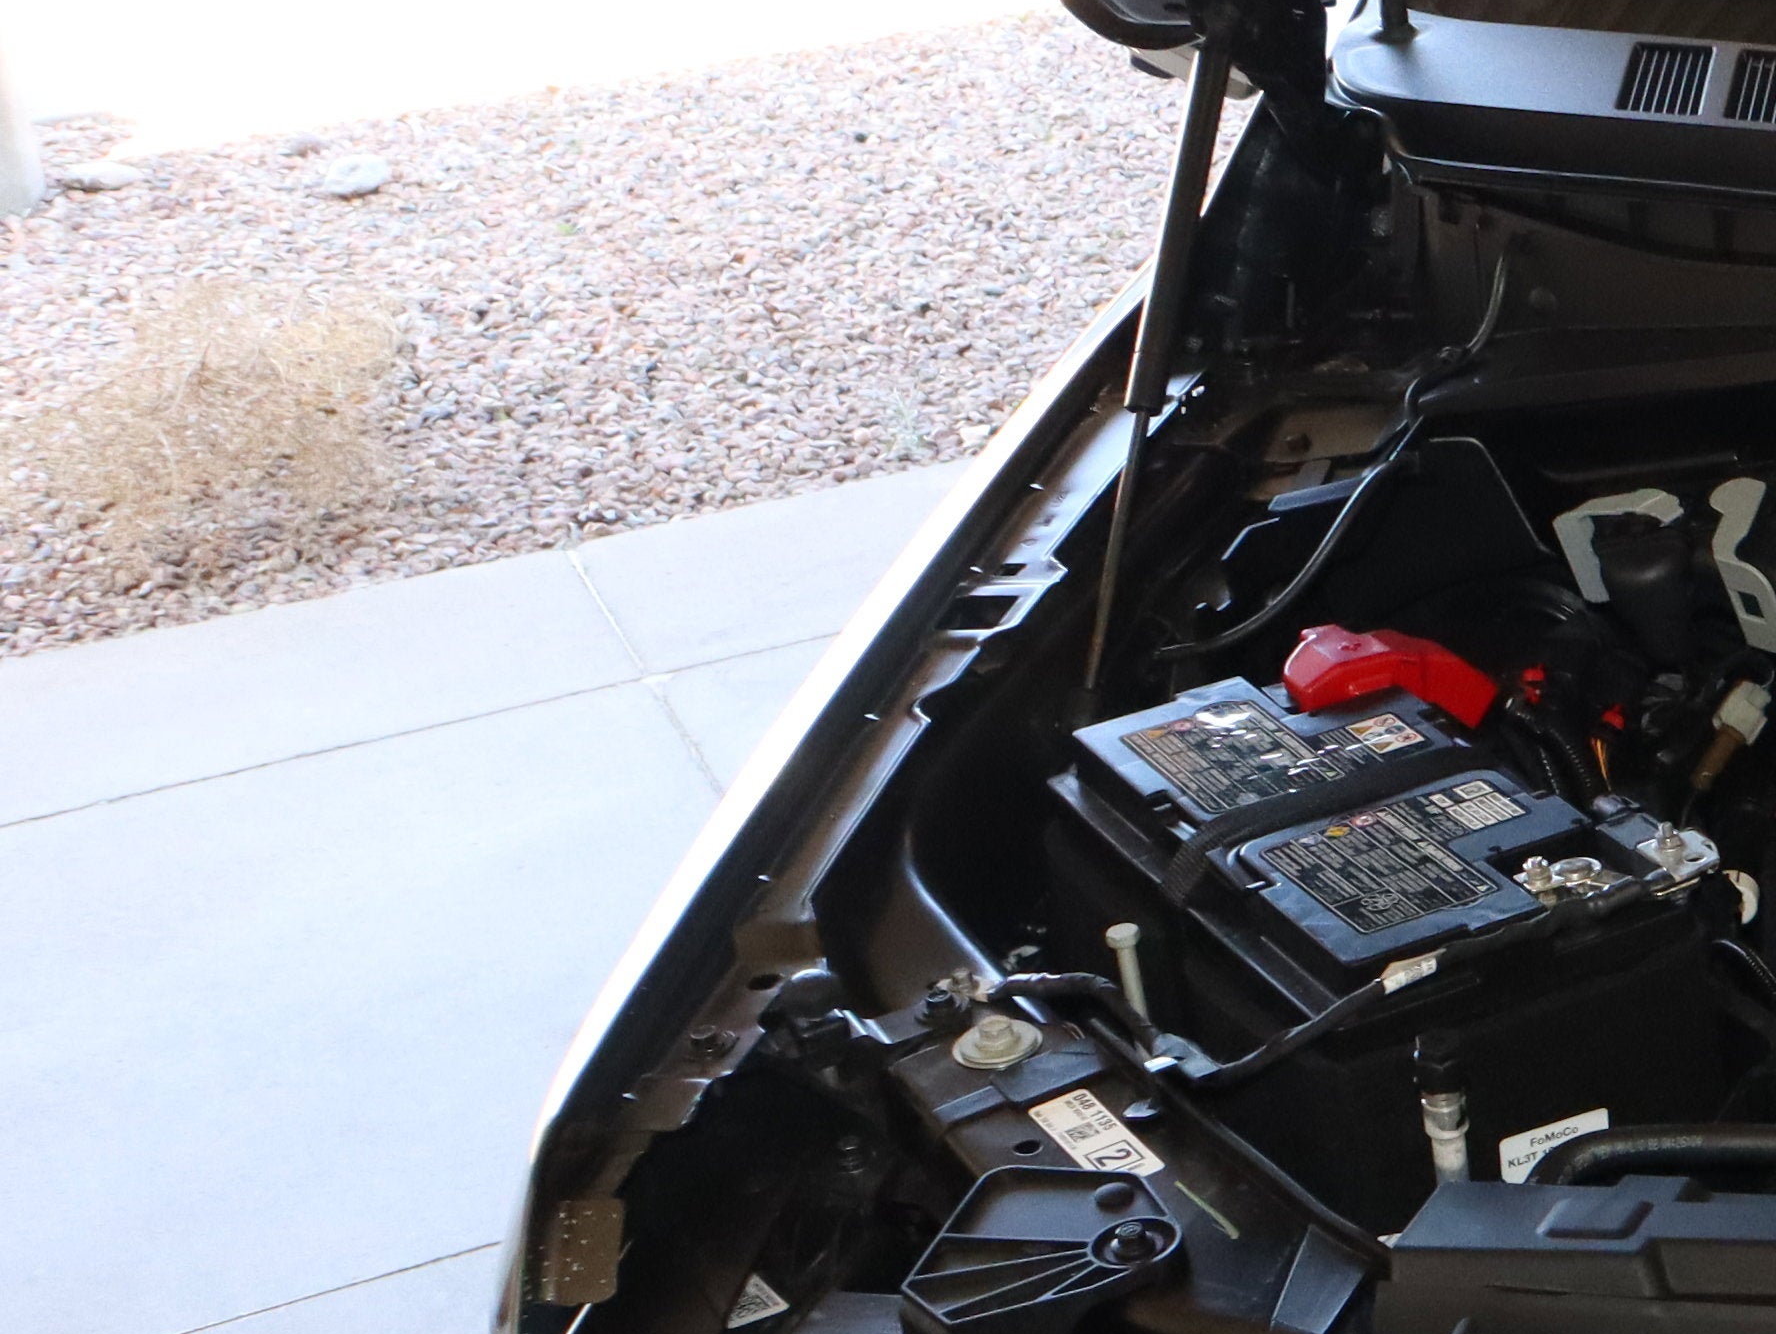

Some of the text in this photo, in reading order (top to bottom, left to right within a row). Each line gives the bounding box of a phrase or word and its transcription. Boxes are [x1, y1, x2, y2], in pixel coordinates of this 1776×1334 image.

[1073, 1093, 1096, 1110] 048
[1090, 1110, 1118, 1131] 1135
[1529, 1126, 1579, 1148] FoMoCo
[1094, 1148, 1132, 1167] 2
[1507, 1151, 1538, 1168] KL3T
